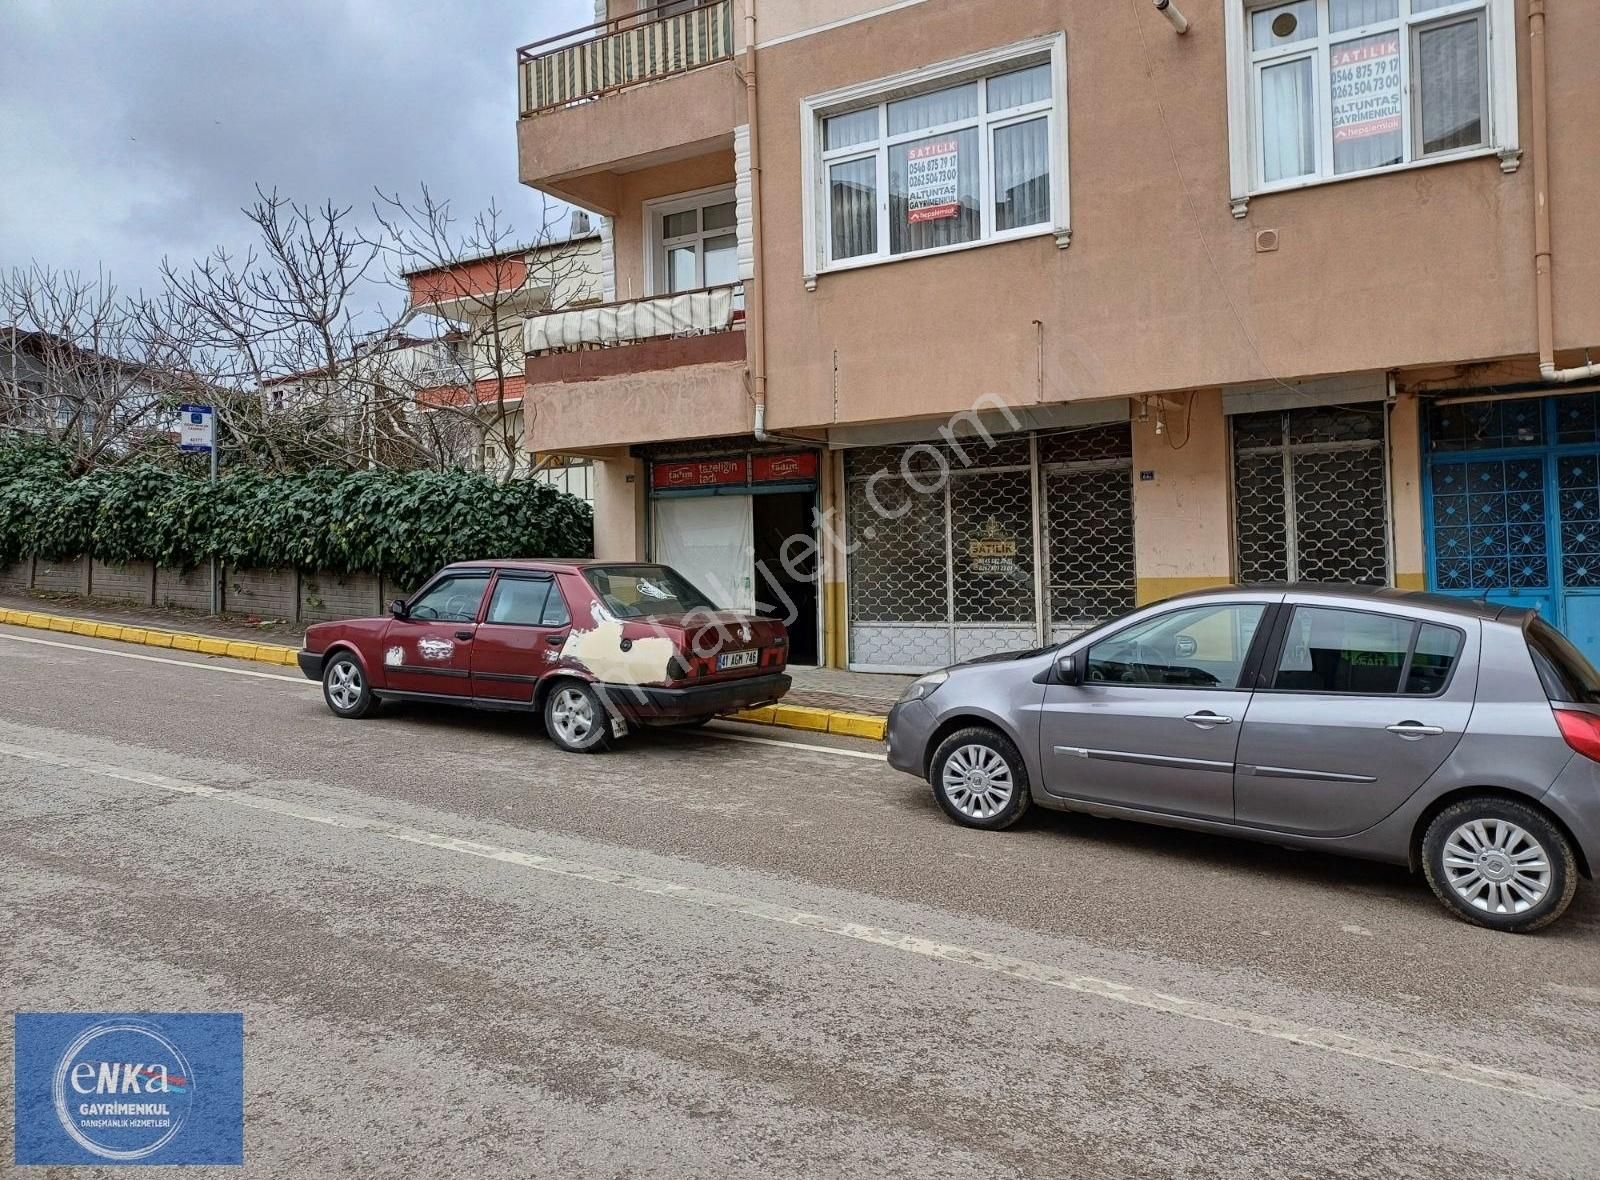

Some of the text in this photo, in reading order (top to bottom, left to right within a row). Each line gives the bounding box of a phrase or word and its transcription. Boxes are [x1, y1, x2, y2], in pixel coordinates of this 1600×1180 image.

[1332, 42, 1397, 66] SATILIK
[1331, 57, 1399, 86] 0546 875 79 17
[1332, 74, 1399, 100] 0262 504 73 00
[909, 142, 956, 160] SATILIK
[909, 154, 957, 176] 0546 875 79 17
[909, 168, 957, 188] 0262 504 73 00
[699, 461, 738, 474] tazeliğin
[721, 651, 758, 667] 41 AGM 746
